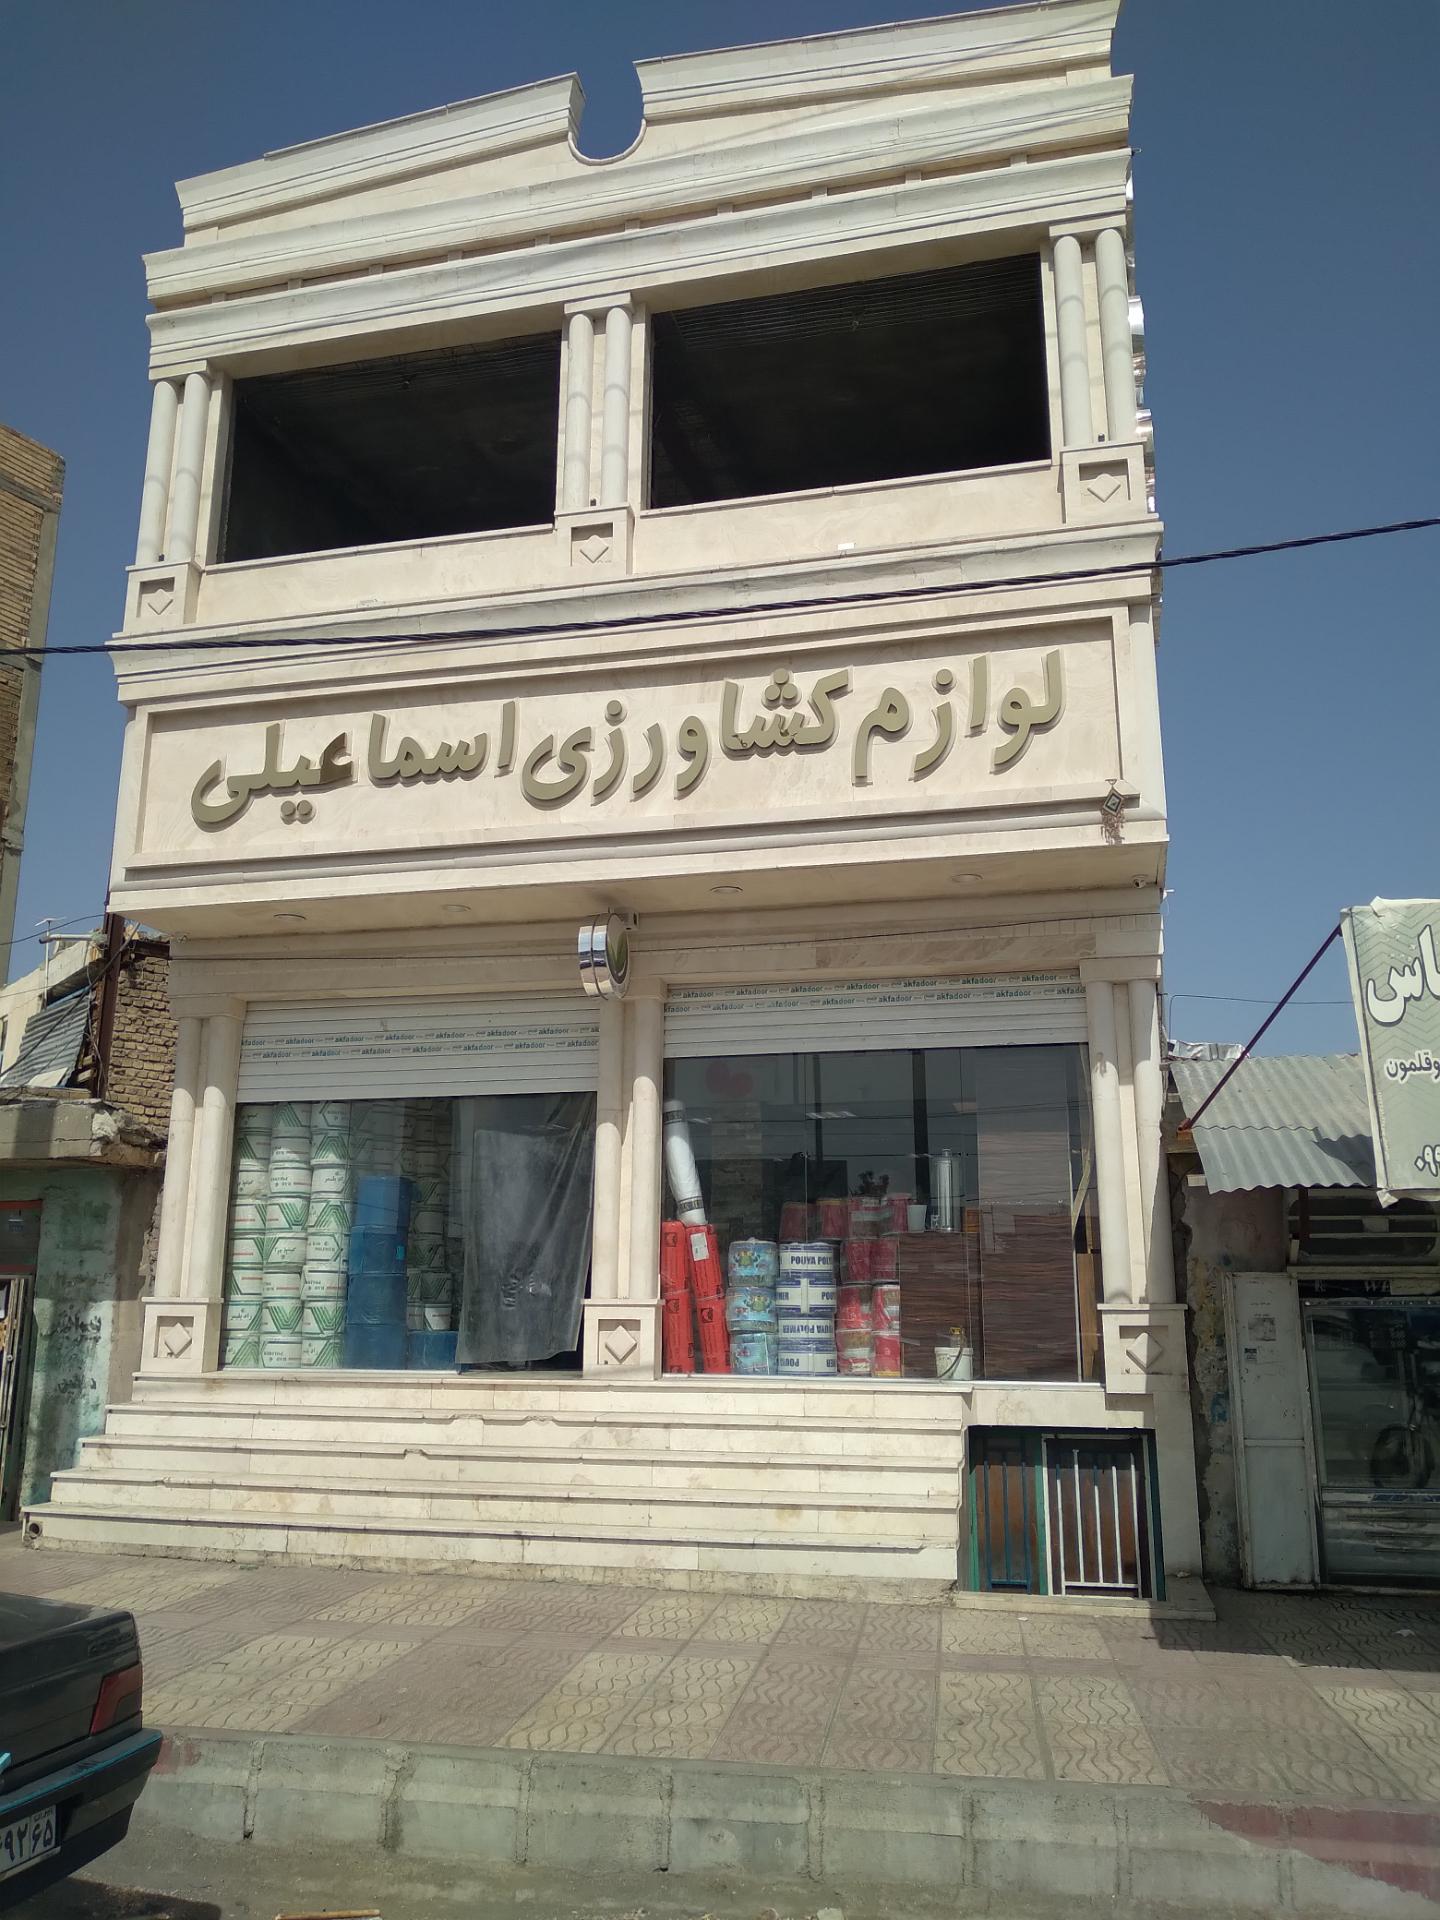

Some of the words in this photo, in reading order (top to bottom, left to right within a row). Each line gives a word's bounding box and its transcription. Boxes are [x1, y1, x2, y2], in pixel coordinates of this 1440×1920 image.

[190, 700, 517, 826] اسماعیلی
[521, 667, 851, 803] کشاورزی
[852, 648, 1064, 782] لوازم
[790, 1255, 816, 1265] POUYA
[0, 1823, 29, 1862] ۹۲
